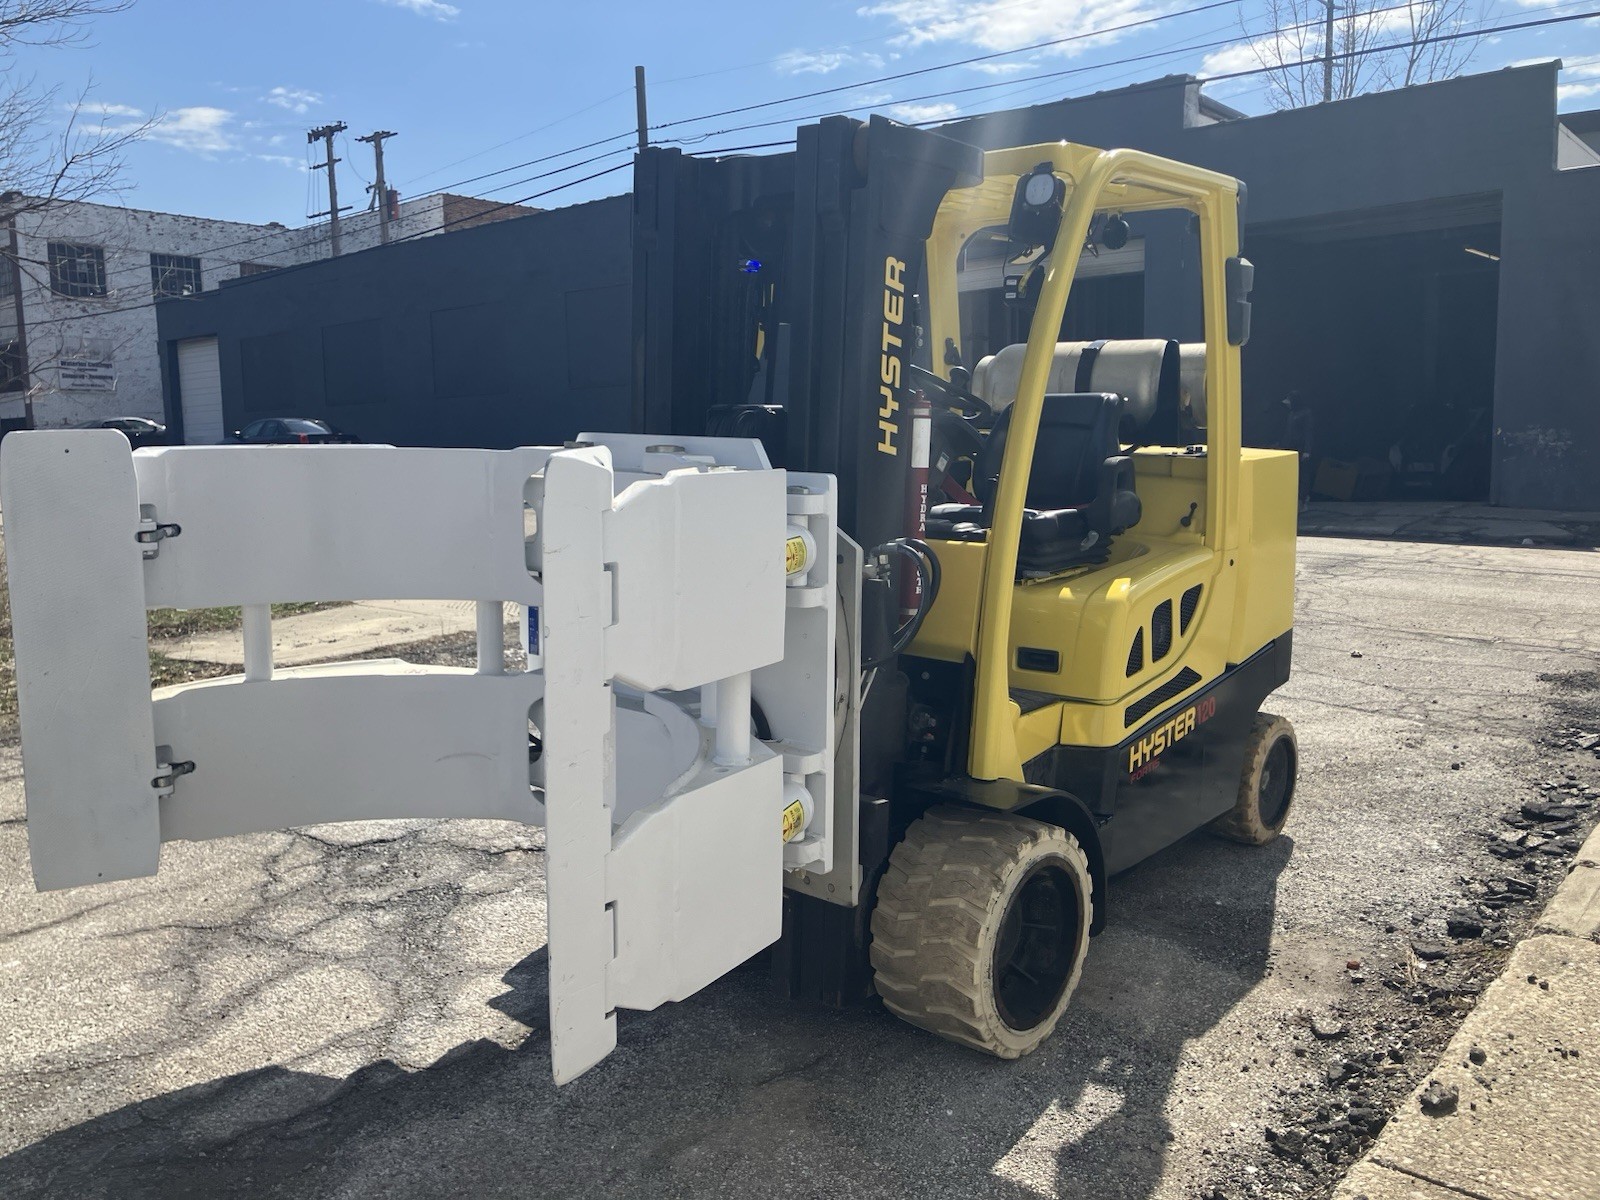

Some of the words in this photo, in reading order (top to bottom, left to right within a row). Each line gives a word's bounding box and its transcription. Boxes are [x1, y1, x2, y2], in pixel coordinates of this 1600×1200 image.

[877, 256, 906, 456] HYSTER
[919, 484, 928, 532] HYDRA
[1129, 706, 1196, 774] HYSTER
[1196, 696, 1216, 725] 120
